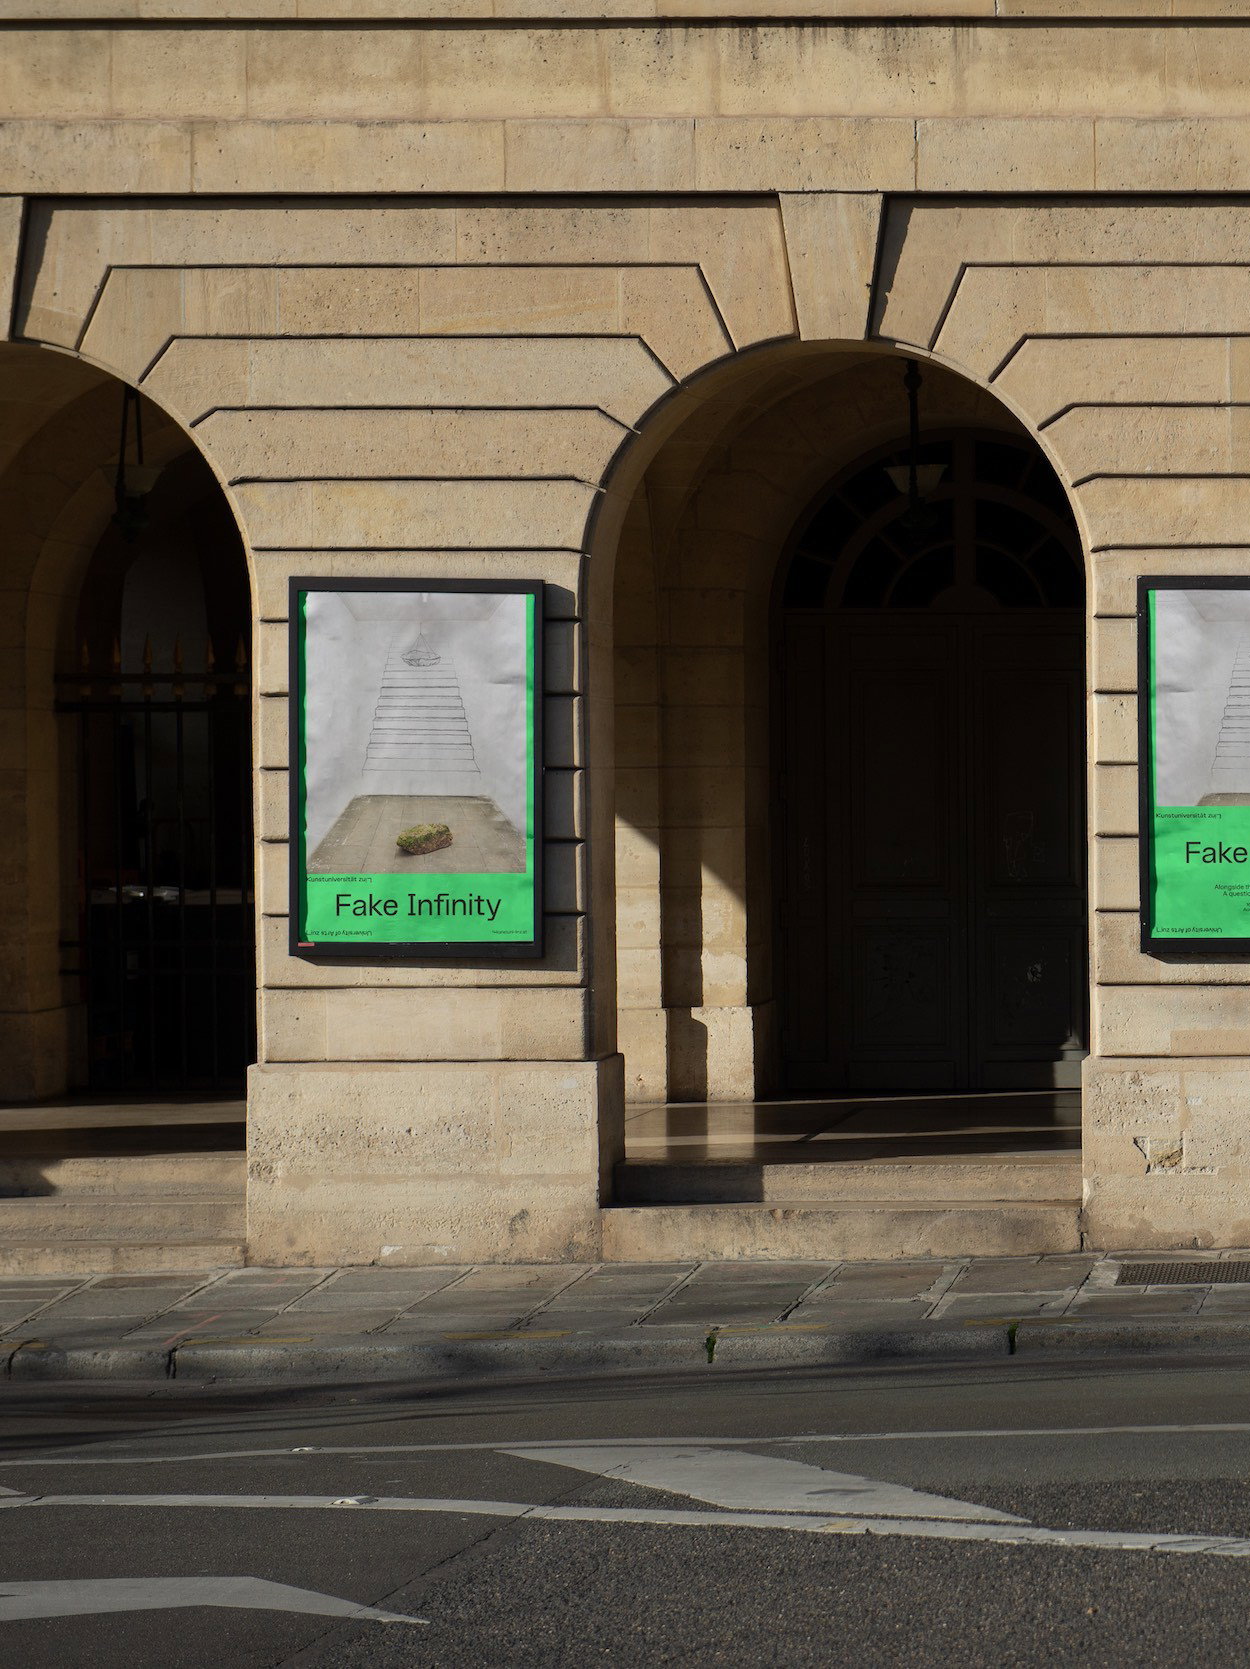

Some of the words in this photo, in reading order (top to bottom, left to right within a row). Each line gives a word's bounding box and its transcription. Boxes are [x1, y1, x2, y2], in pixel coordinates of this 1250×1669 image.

[1185, 841, 1249, 864] Fake
[335, 893, 399, 917] Fake
[407, 893, 502, 922] Infinity
